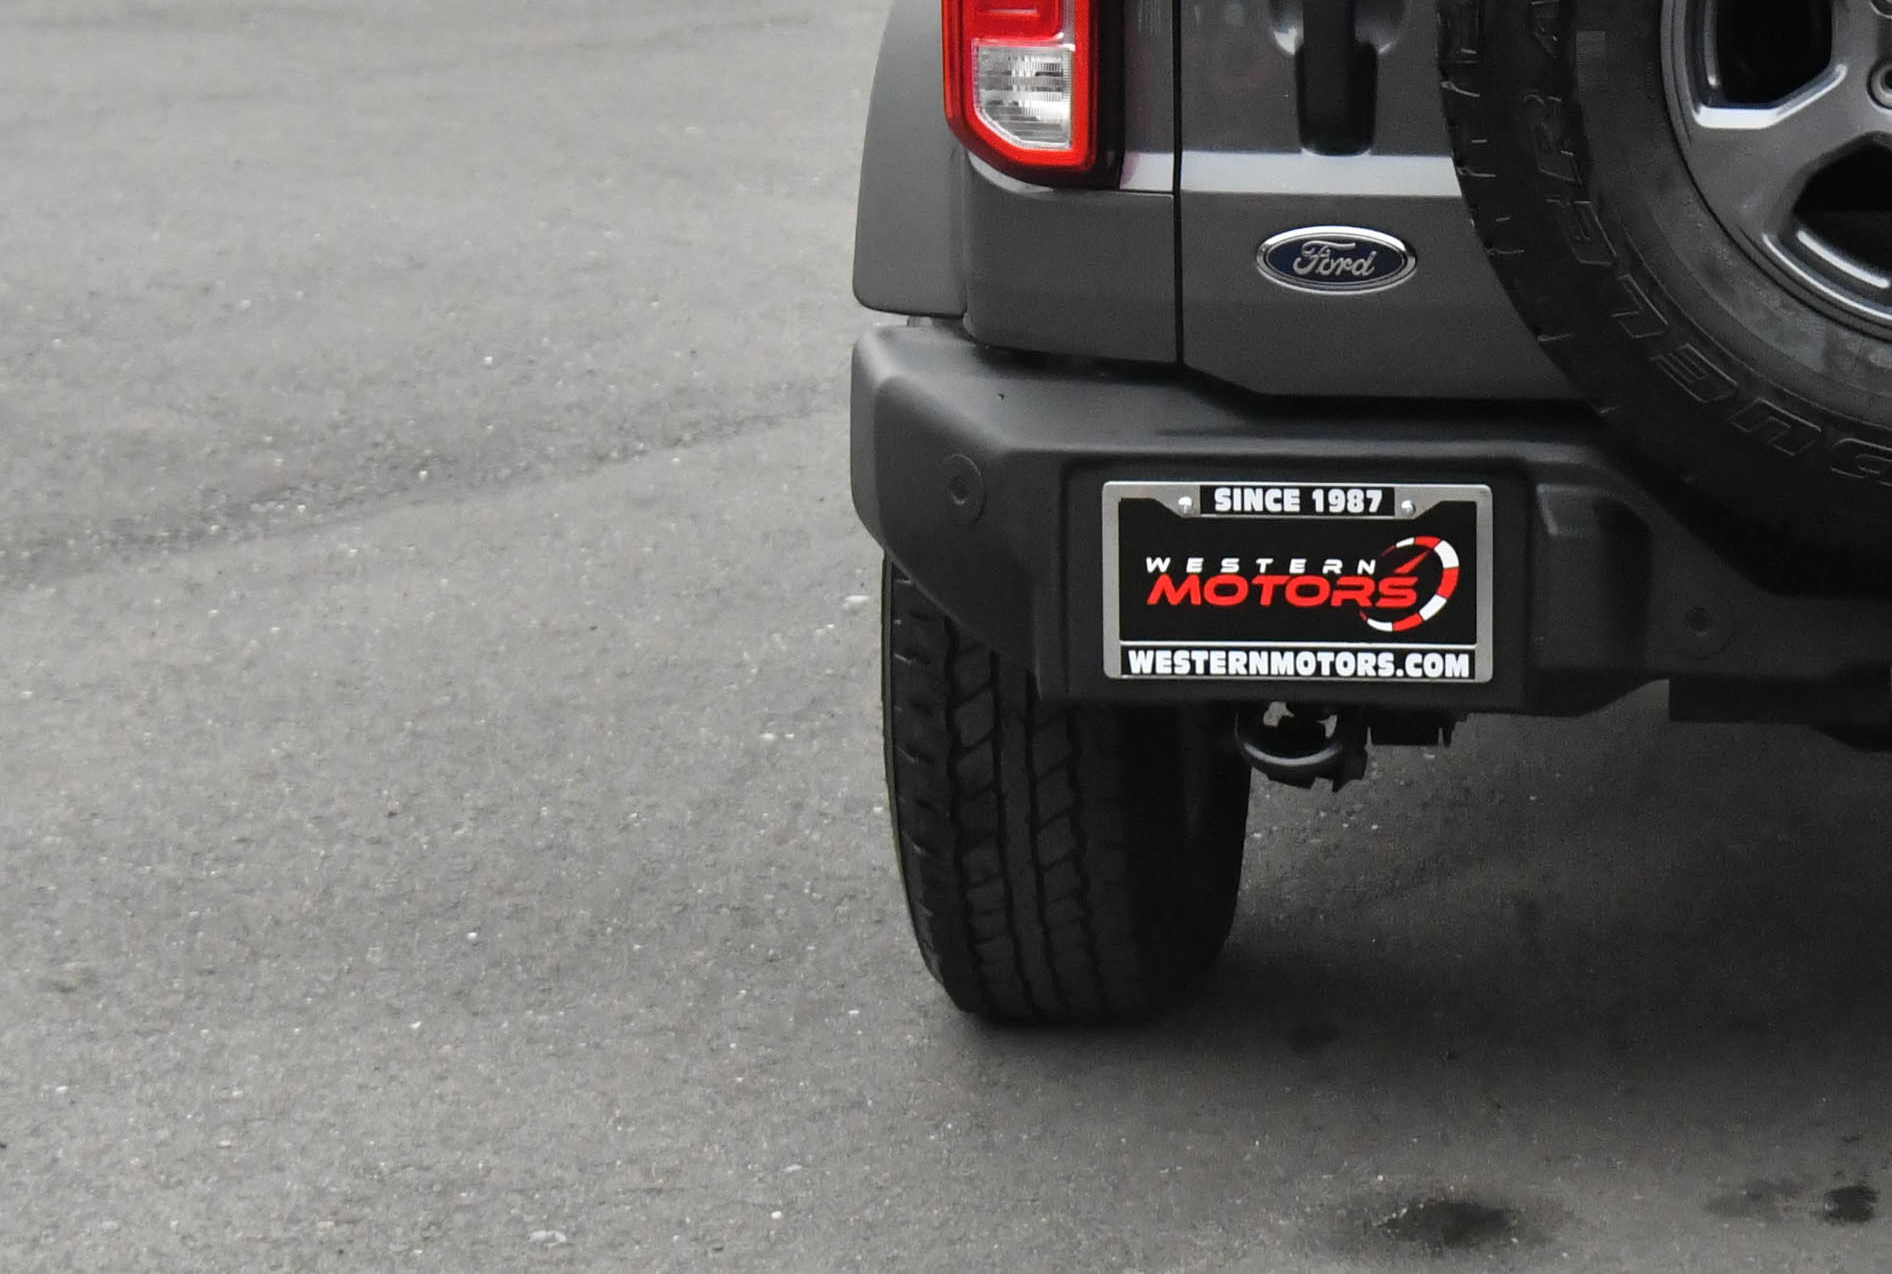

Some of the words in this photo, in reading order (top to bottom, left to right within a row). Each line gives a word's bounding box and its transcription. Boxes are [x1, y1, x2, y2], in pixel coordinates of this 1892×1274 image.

[1293, 240, 1378, 277] Ford
[1214, 487, 1301, 513] SINCE
[1311, 488, 1383, 514] 1987
[1145, 557, 1377, 574] WESTERN
[1146, 574, 1419, 608] MOTORS
[1127, 649, 1471, 679] WESTERNMOTORS.COM
